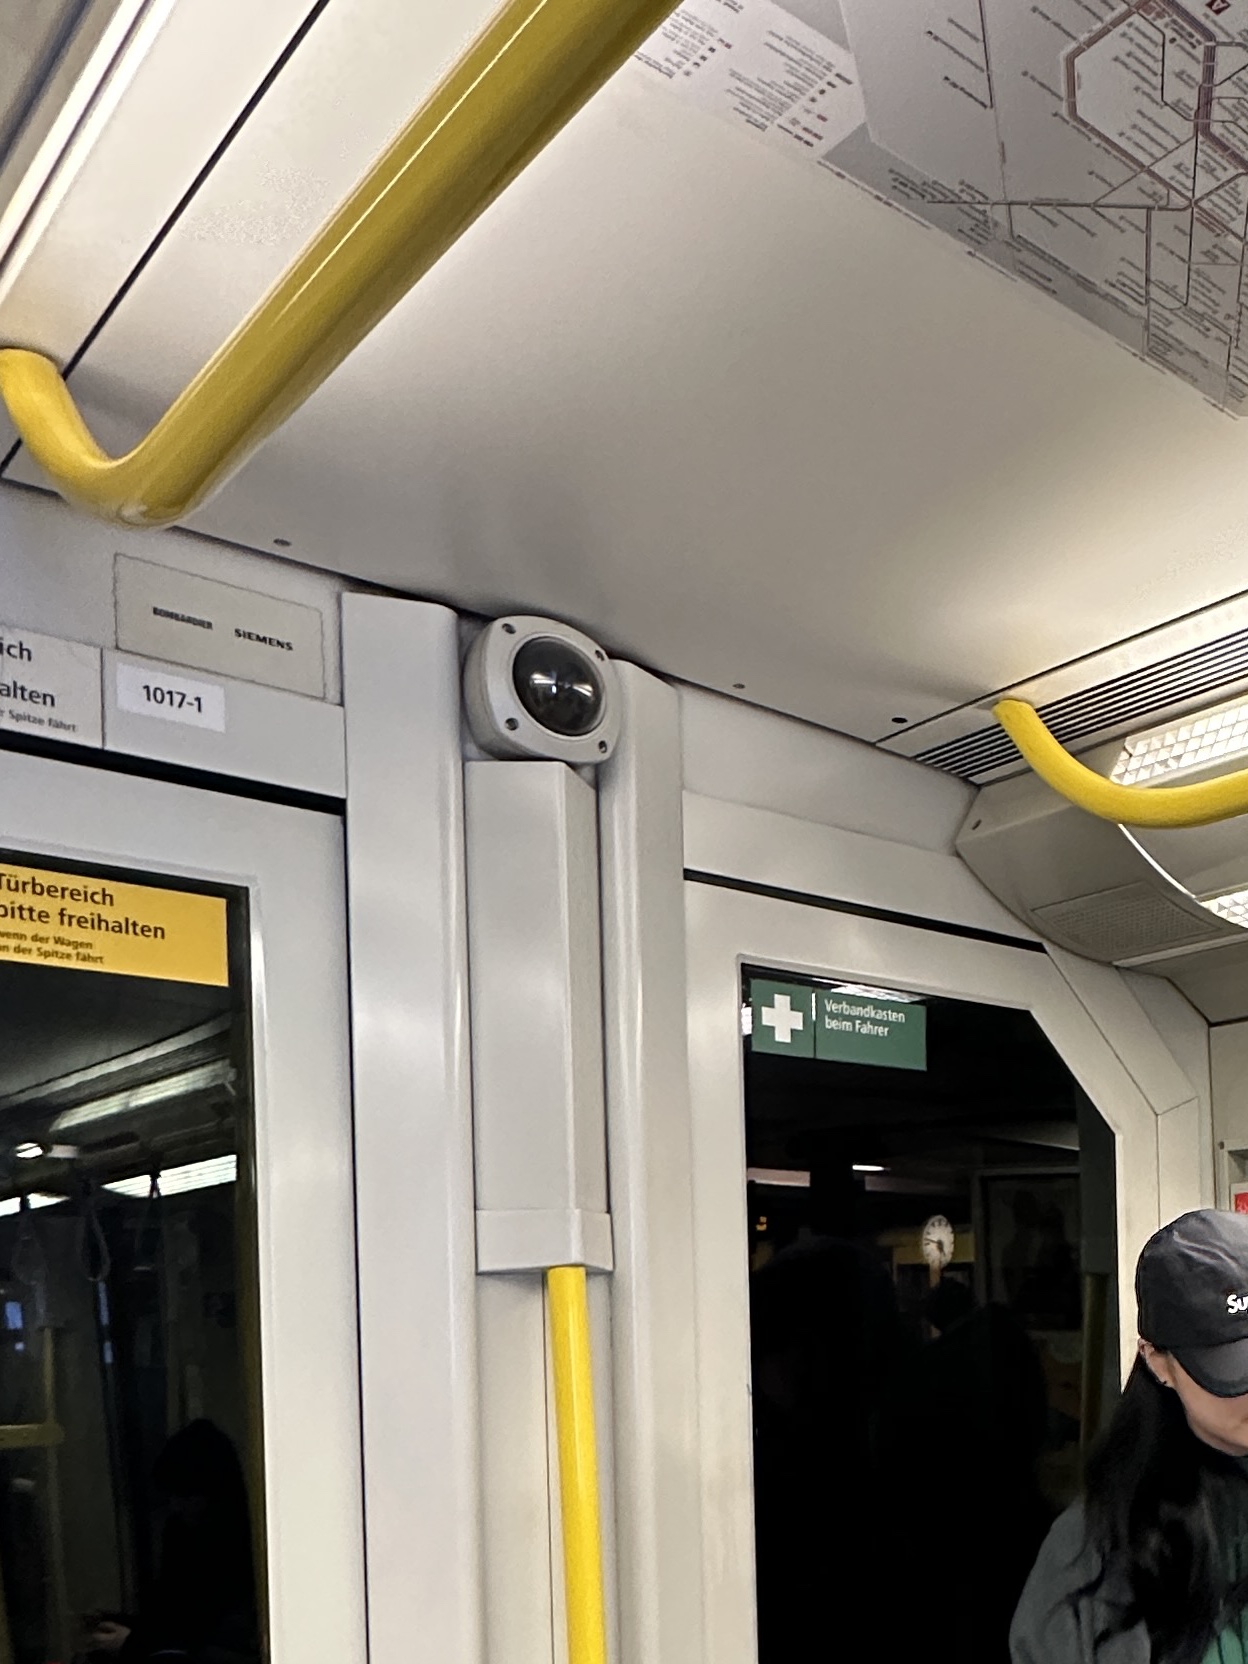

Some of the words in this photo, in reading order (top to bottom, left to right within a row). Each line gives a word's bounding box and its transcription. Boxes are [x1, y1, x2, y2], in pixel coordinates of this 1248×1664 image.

[234, 628, 293, 651] SIEMENS
[0, 680, 55, 708] alten
[143, 684, 202, 713] 1017-1
[0, 872, 114, 906] Türbereich
[58, 908, 165, 940] freihalten
[36, 946, 72, 961] Spitze
[53, 935, 93, 950] Wagen
[824, 998, 905, 1023] Verbandkasten
[824, 1014, 853, 1032] beim
[855, 1020, 889, 1037] Fahrer
